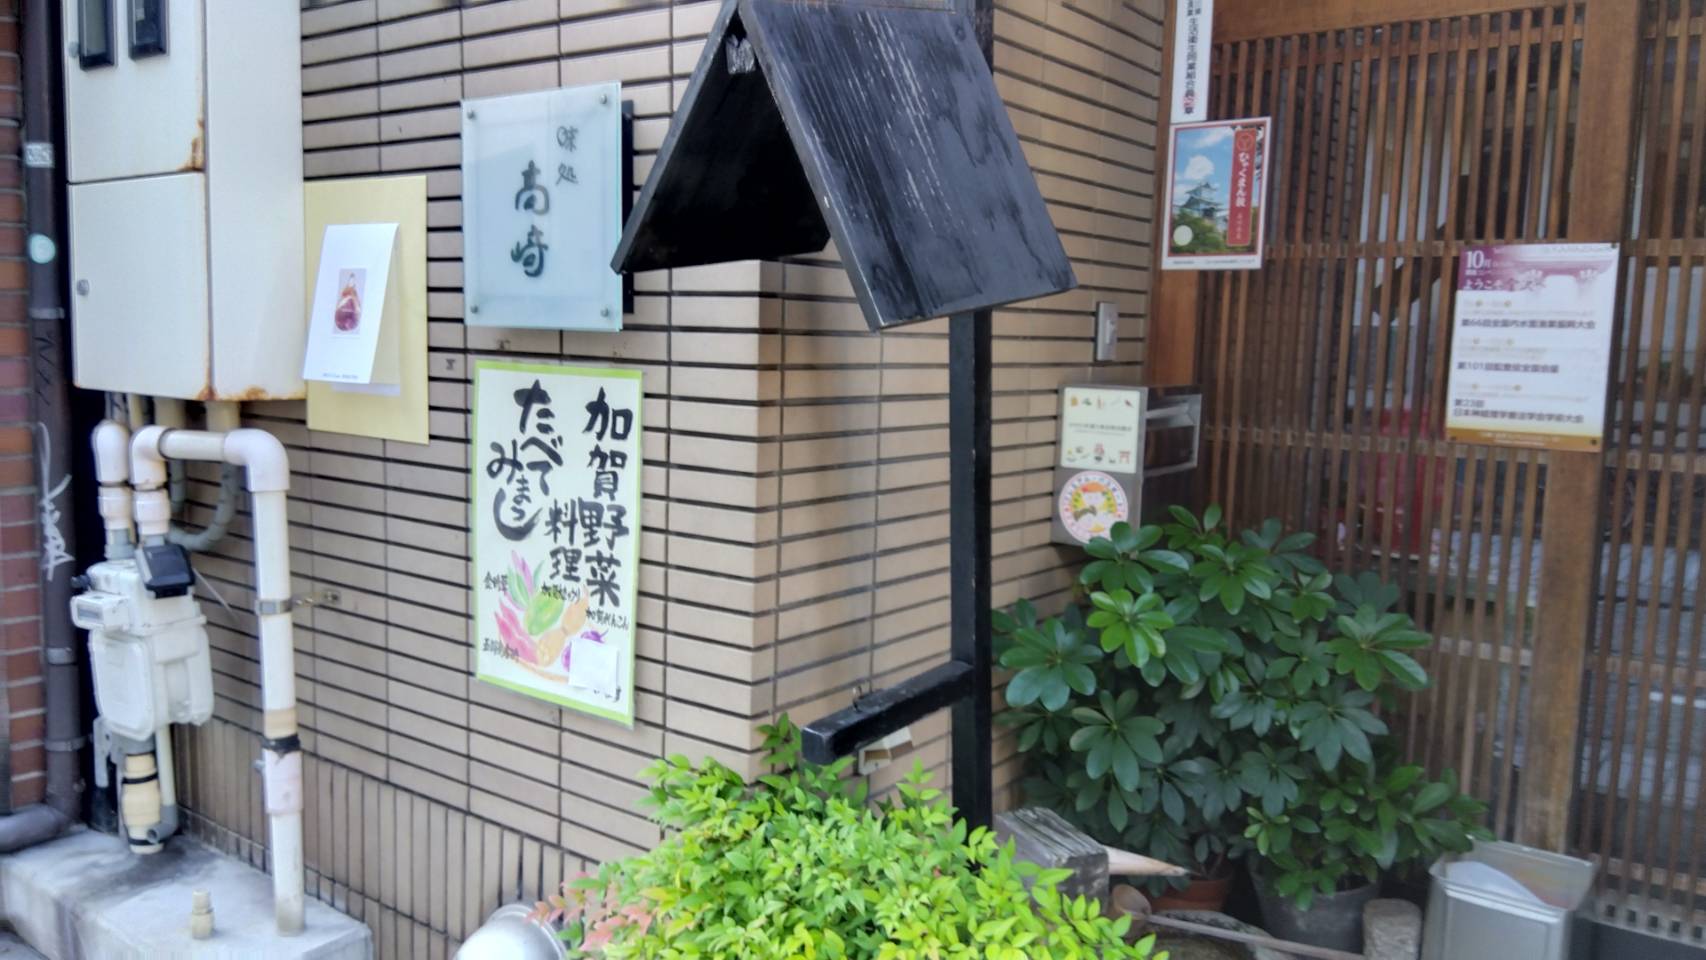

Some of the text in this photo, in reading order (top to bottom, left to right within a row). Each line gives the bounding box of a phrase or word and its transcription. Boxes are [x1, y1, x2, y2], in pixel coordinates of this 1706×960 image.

[513, 379, 564, 496] たべて
[544, 498, 583, 583] 料理
[581, 386, 634, 608] 加賀野菜
